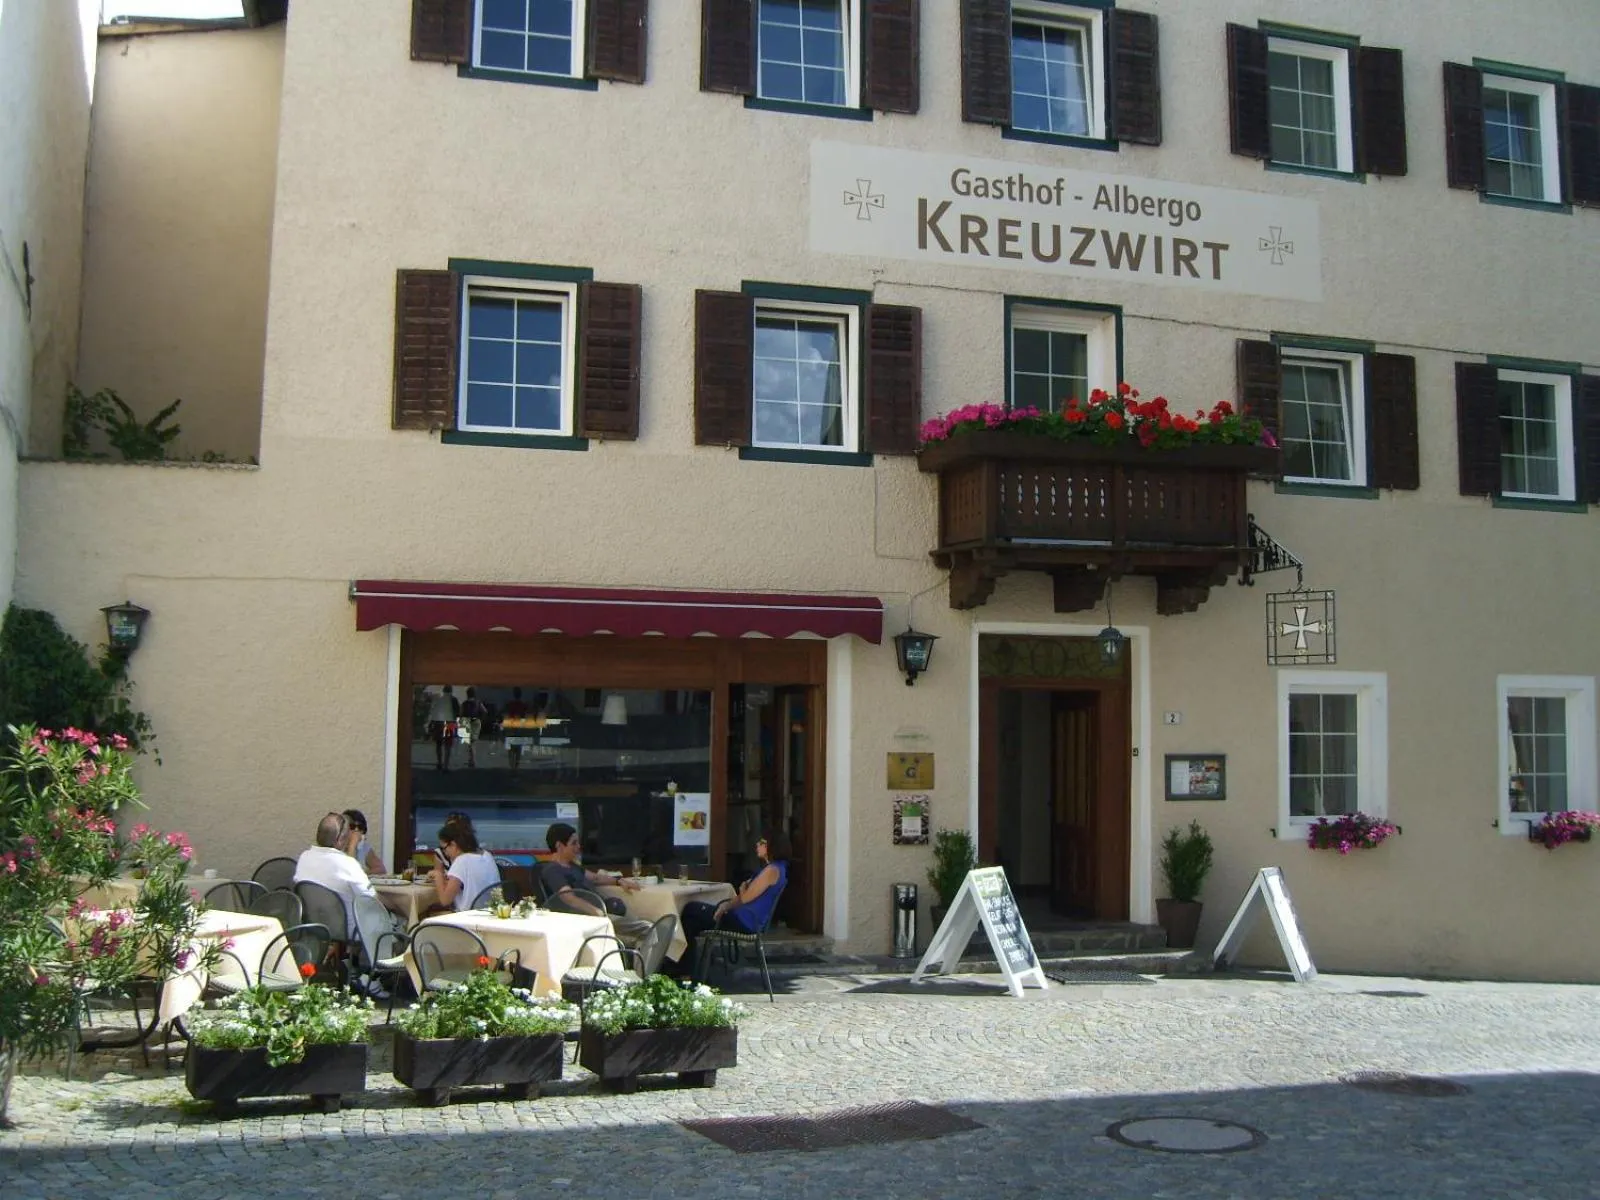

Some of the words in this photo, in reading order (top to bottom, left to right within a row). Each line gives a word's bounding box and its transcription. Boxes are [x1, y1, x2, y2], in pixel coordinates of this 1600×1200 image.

[951, 168, 1065, 206] Gasthof
[1093, 184, 1202, 226] Albergo
[917, 198, 1229, 280] KREUZWIRT
